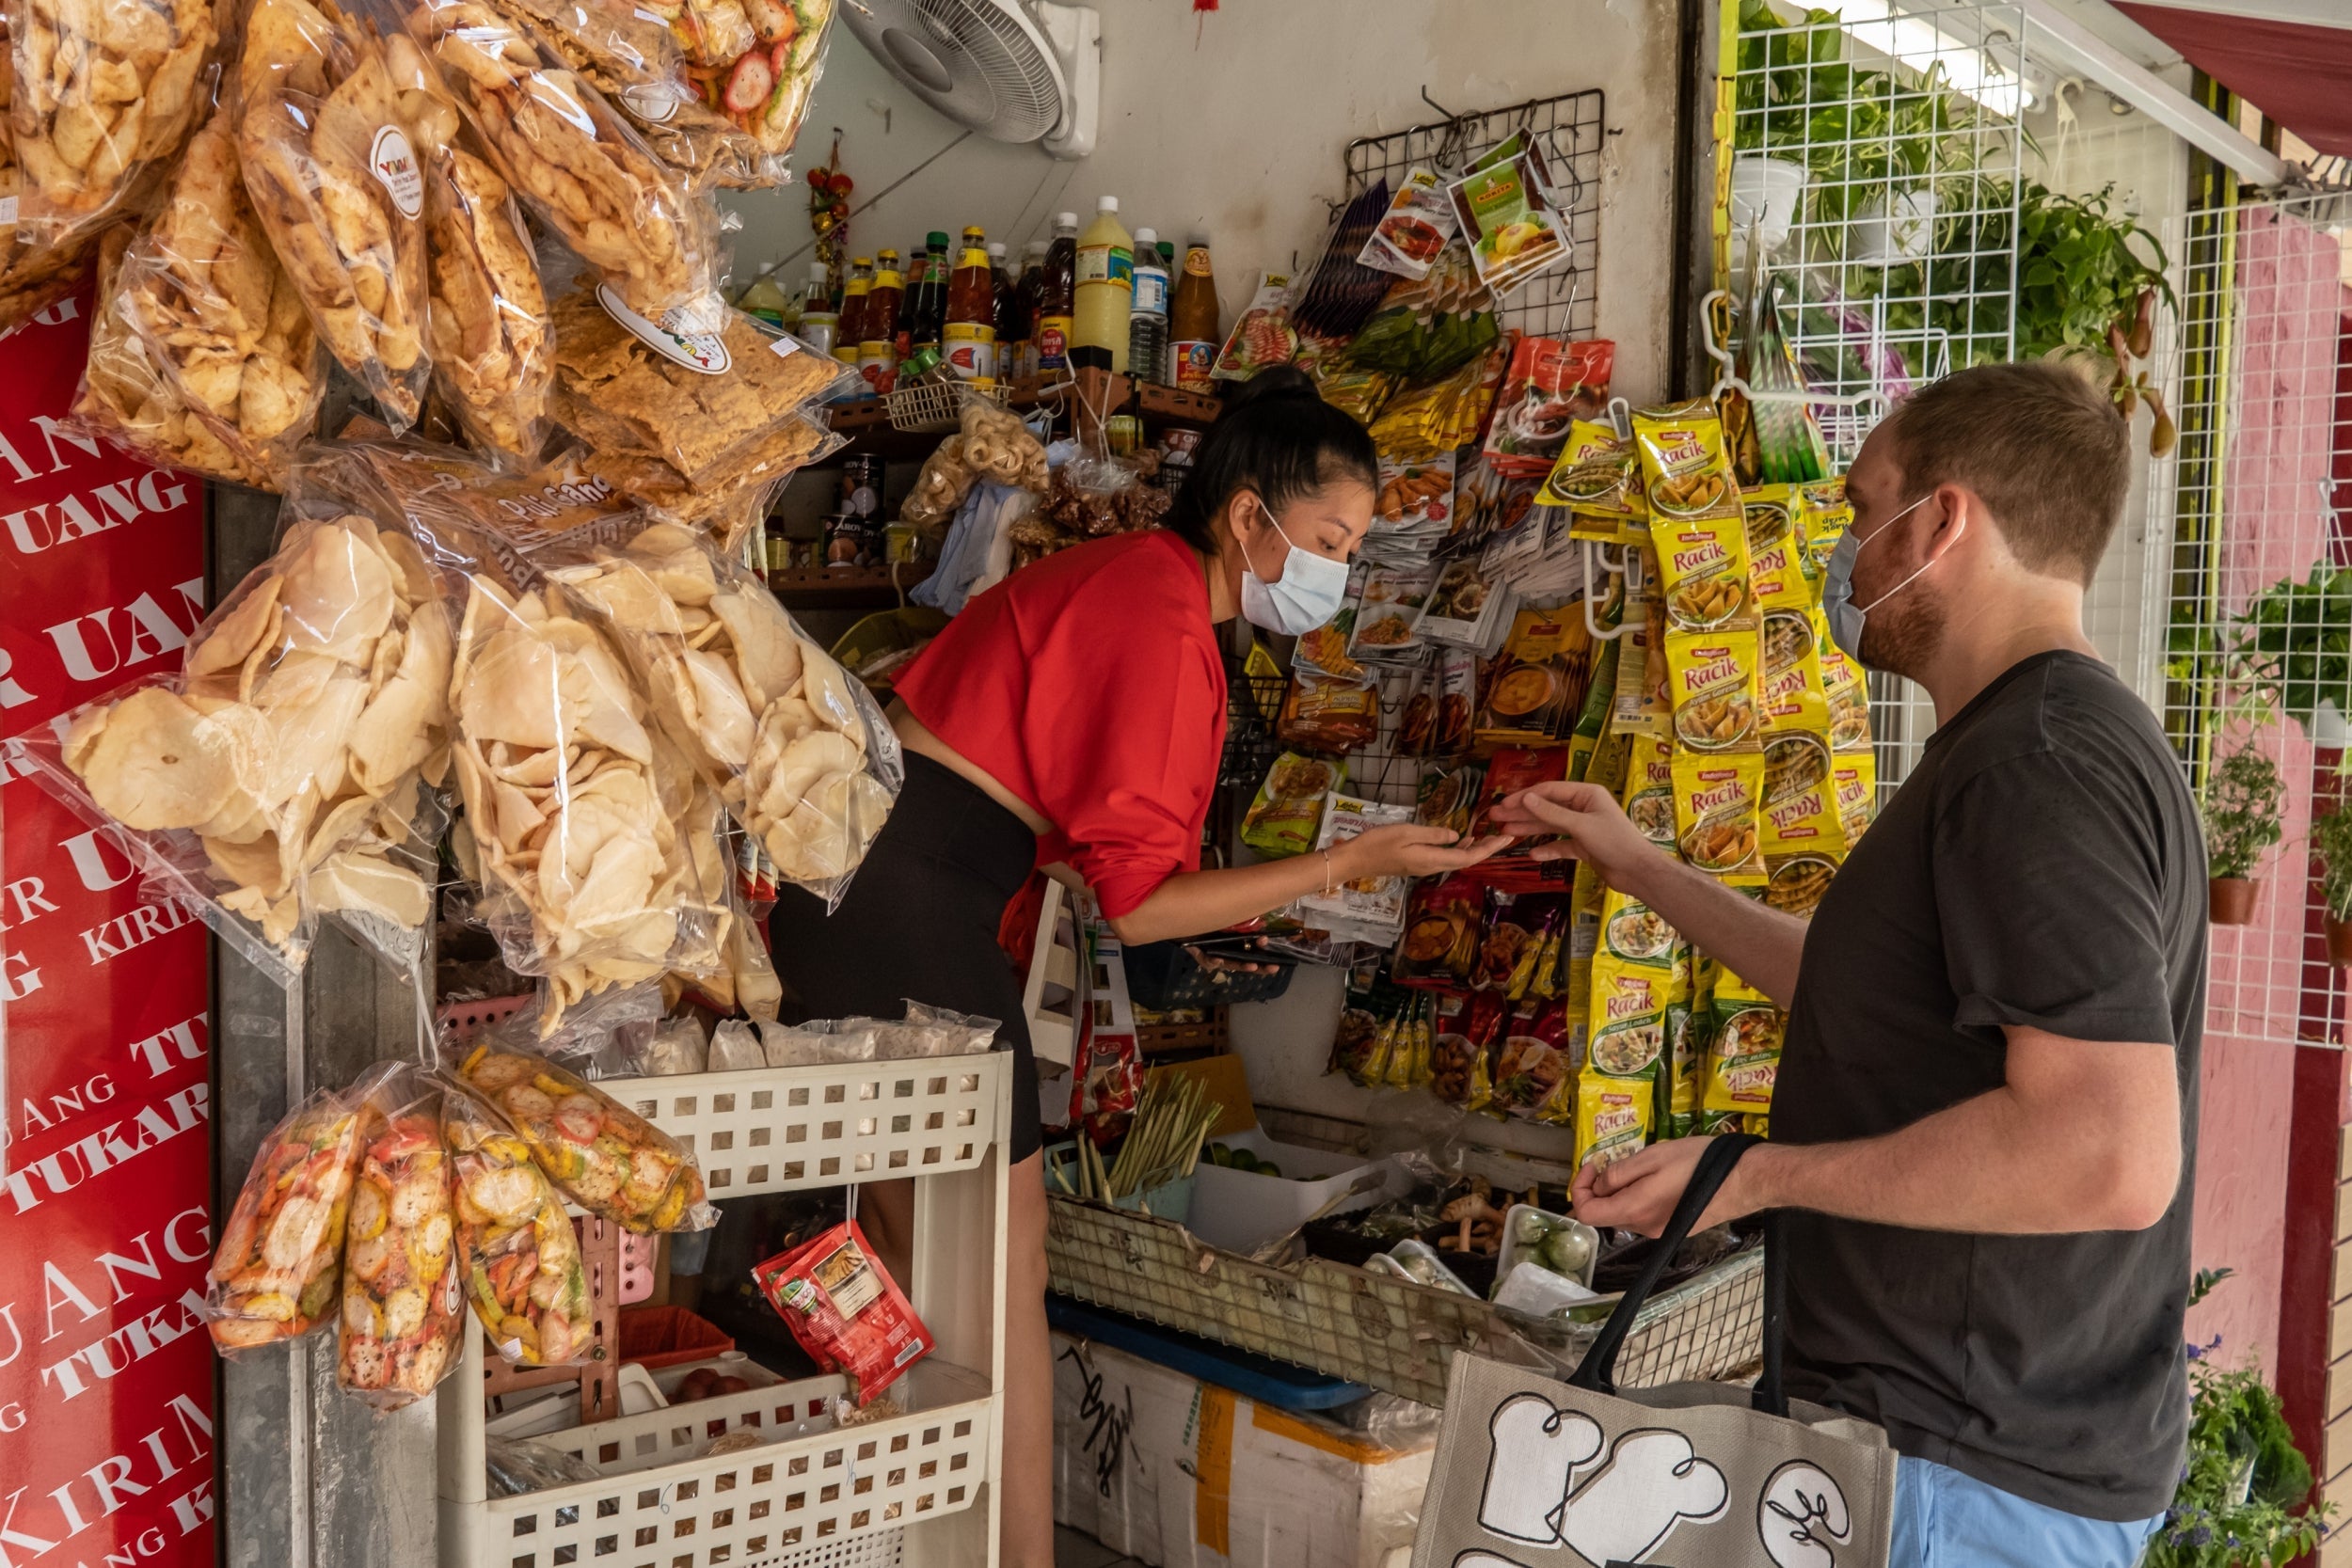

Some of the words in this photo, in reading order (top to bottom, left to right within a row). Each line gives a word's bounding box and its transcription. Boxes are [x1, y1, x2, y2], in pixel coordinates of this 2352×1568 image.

[1659, 440, 1706, 466] Racik
[1, 470, 188, 554] UANG
[1674, 543, 1725, 572] Racik
[1684, 657, 1740, 690] Racik
[1692, 781, 1745, 814] Racik
[1769, 793, 1822, 829] Racik
[1837, 782, 1867, 809] acik
[1607, 992, 1655, 1018] Racik
[1594, 1108, 1637, 1135] Racik
[4, 1082, 208, 1216] TUKAR
